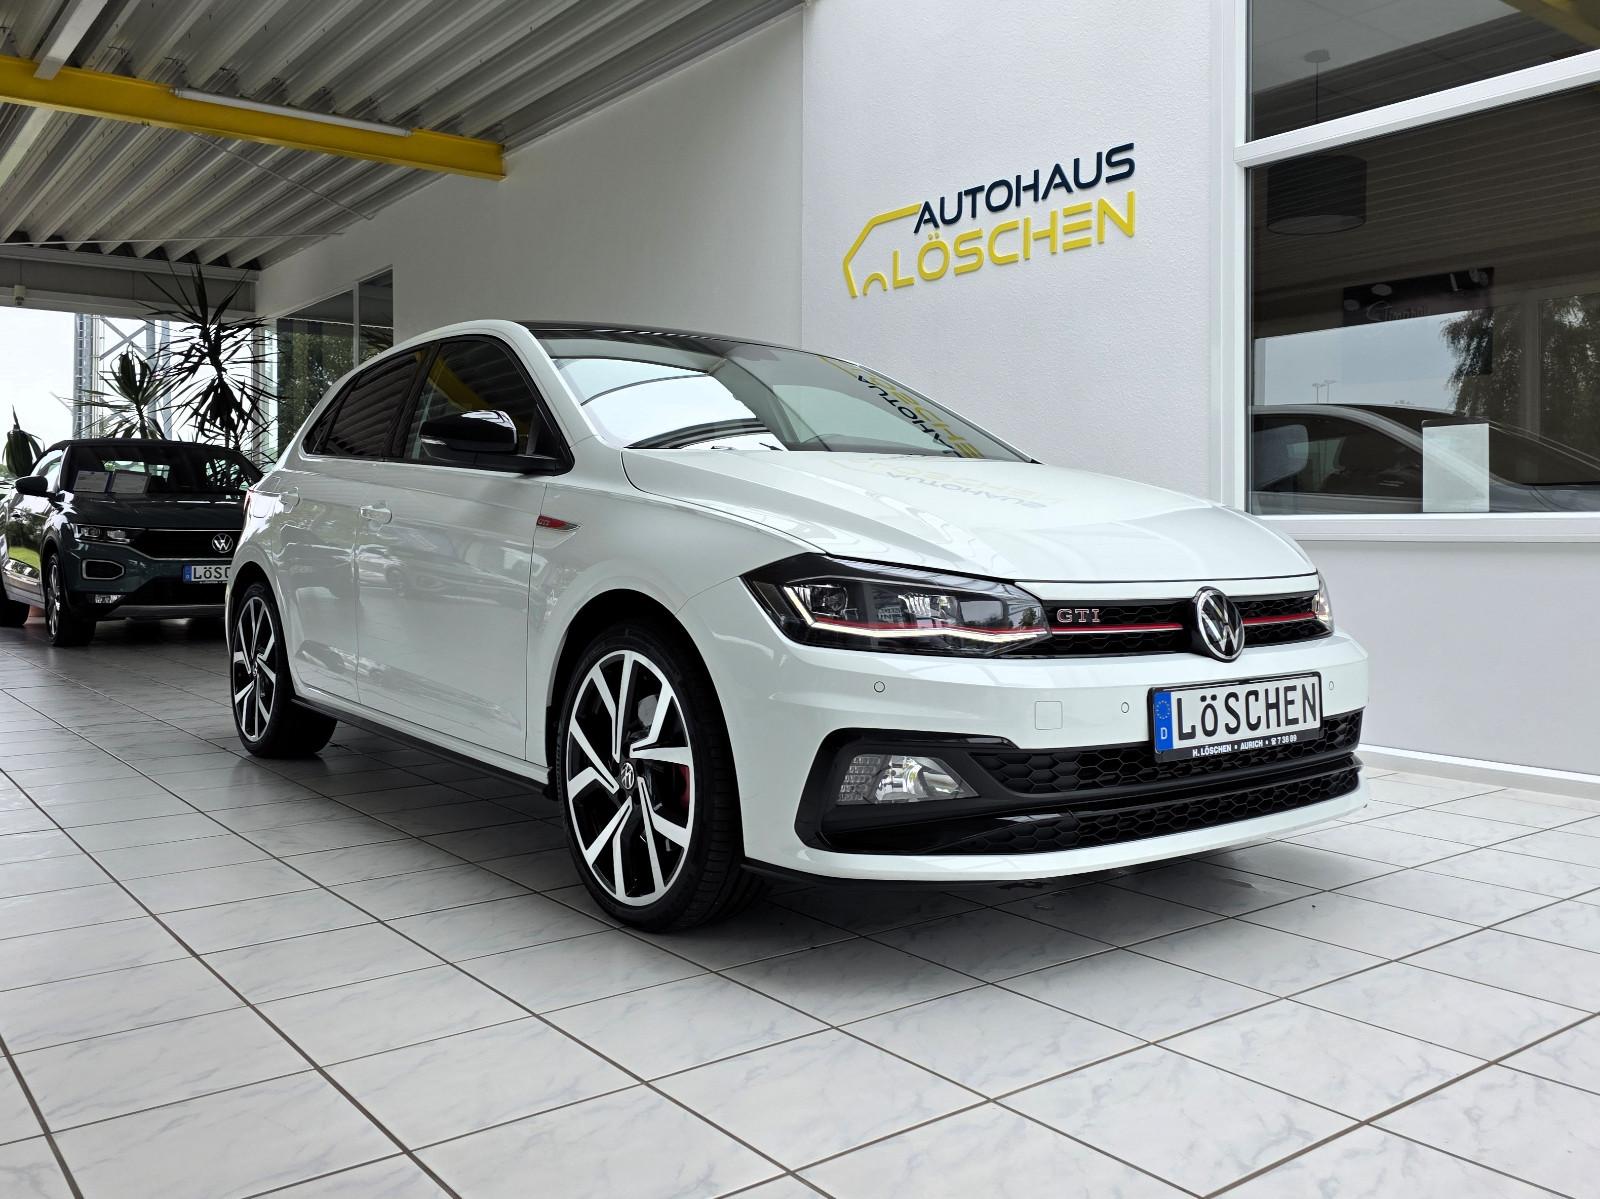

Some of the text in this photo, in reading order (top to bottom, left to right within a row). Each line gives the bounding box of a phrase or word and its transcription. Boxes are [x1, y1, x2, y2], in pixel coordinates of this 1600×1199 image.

[913, 142, 1136, 235] AUTOHAUS
[891, 189, 1137, 290] LÖSCHEN
[1056, 608, 1100, 623] GTI
[1160, 727, 1168, 739] D
[1201, 744, 1232, 756] LÖSCHEN
[1240, 739, 1263, 750] AURICH
